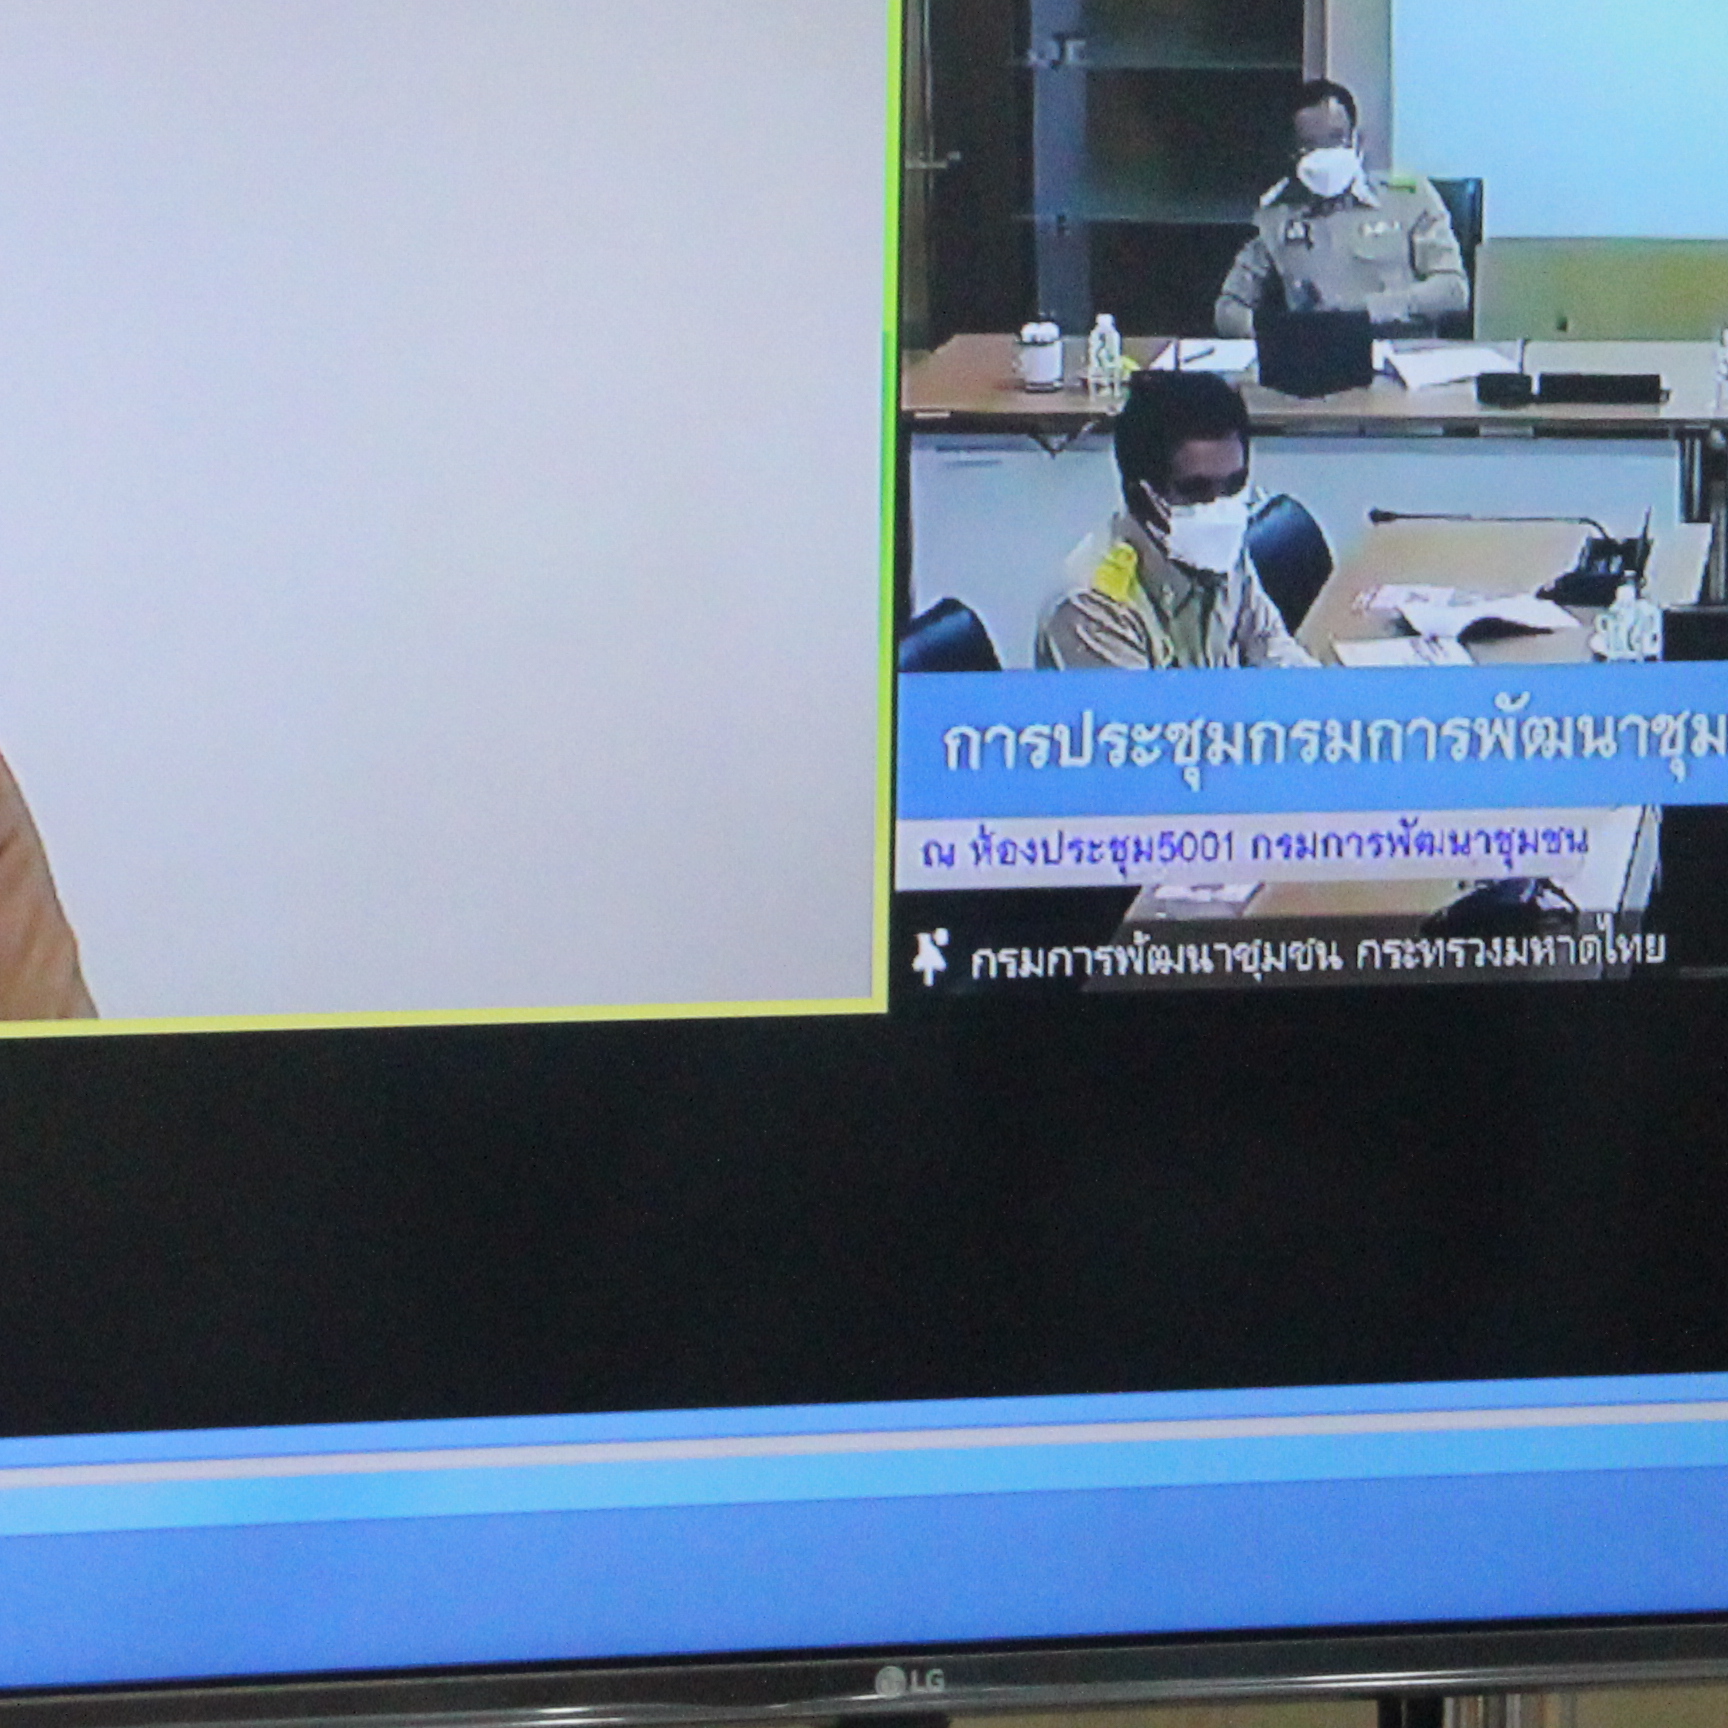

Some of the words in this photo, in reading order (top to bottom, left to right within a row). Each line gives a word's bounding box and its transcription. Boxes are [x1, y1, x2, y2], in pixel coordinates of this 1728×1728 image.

[1251, 818, 1589, 871] กรมการพัฒนาชุมชน
[971, 932, 1343, 981] กรมการพัฒนาชุมชน
[1357, 913, 1667, 972] กระทรวงมหาดไทย
[910, 1668, 945, 1693] LG
